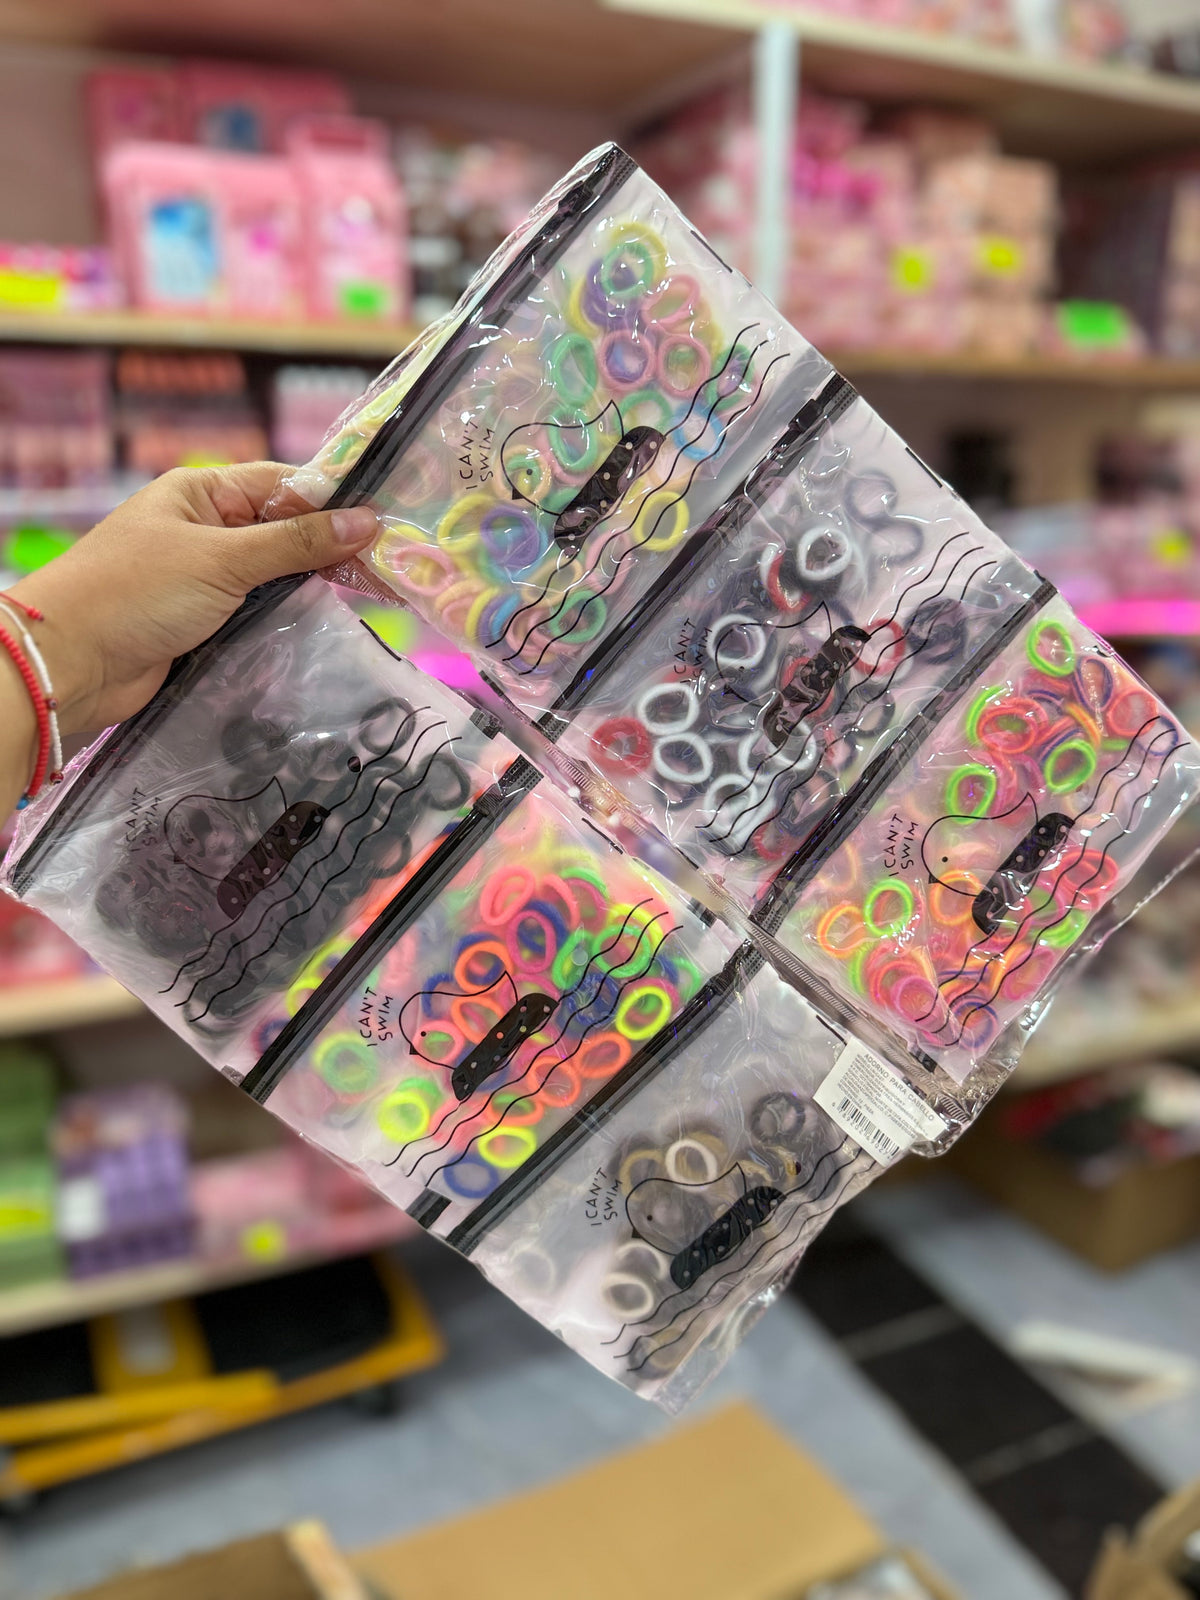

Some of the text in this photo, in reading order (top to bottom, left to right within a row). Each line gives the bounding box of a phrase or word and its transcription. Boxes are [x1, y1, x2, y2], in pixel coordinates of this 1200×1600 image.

[458, 420, 478, 479] CAN'T
[479, 428, 495, 482] SWIM
[674, 617, 696, 674] CAN'T
[692, 627, 713, 678] SWIM
[125, 787, 146, 842] CAN'T
[883, 813, 903, 868] CAN'T
[901, 821, 919, 870] SWIM
[357, 986, 377, 1038] CAN'T
[378, 995, 394, 1041] SWIM
[864, 1053, 936, 1121] ADORNO PARA CABELLO
[586, 1167, 607, 1219] CAN'T
[603, 1179, 622, 1221] SWIM
